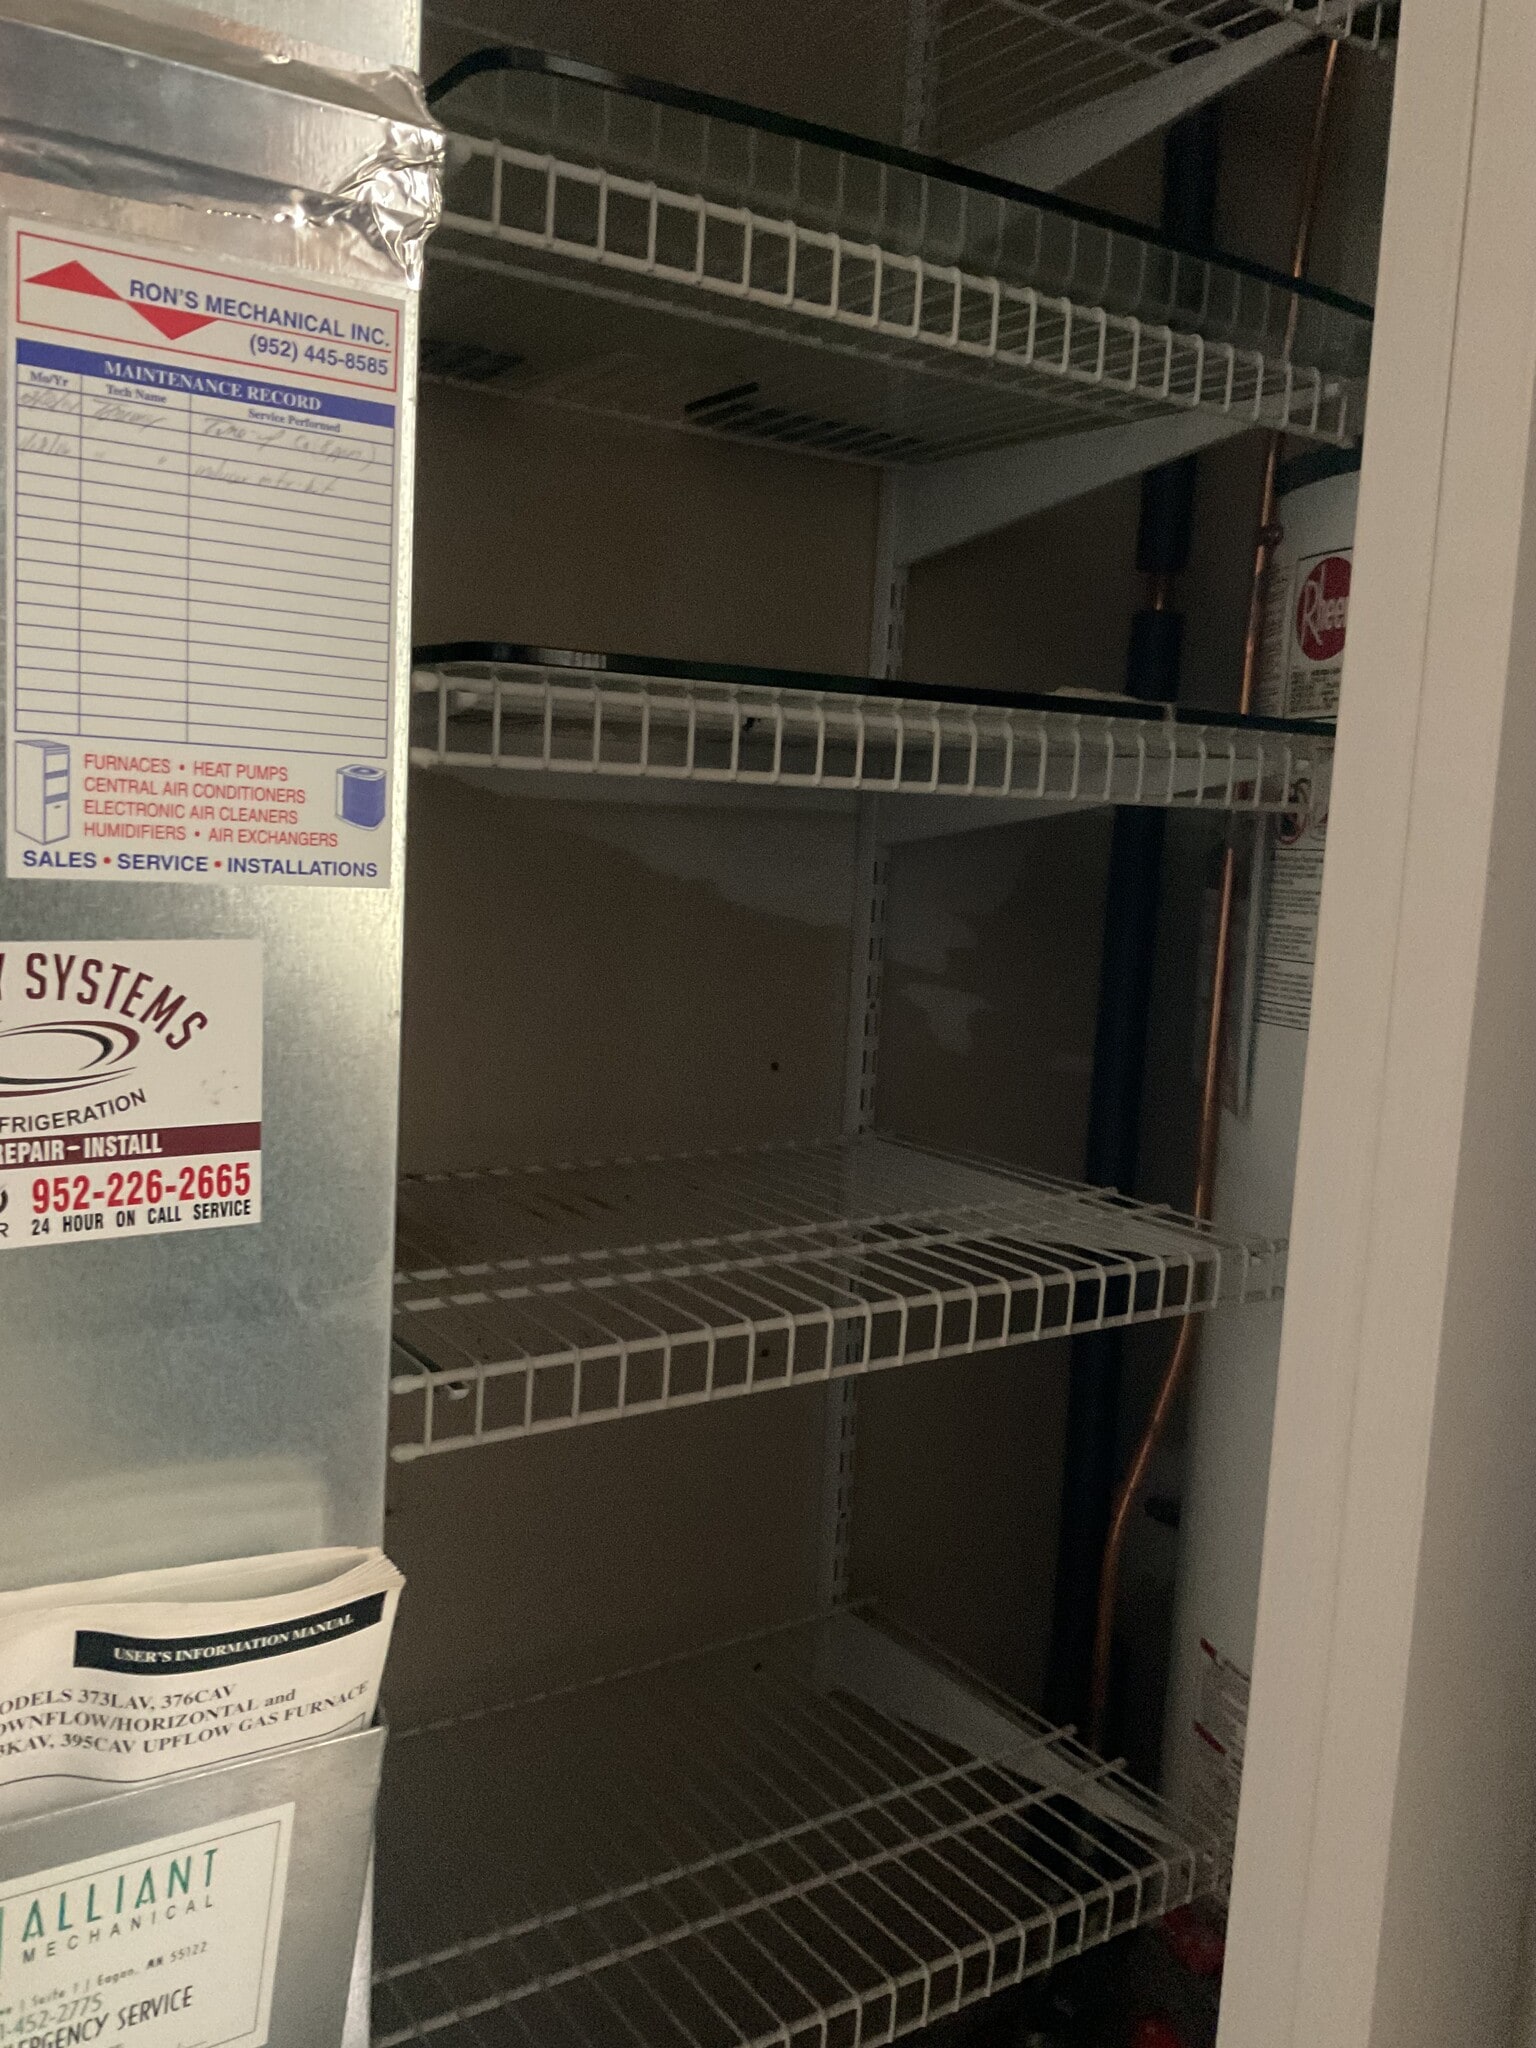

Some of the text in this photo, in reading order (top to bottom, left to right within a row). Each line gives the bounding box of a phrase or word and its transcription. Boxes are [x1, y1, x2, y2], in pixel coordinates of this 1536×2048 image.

[130, 279, 390, 347] RON'S MECHANICAL INC.
[249, 333, 388, 376] (952) 445-8585
[30, 371, 69, 387] Mo/Yr
[104, 360, 321, 411] MAINTENANCE RECORD
[106, 384, 167, 404] Tech Name
[248, 409, 341, 433] Service Performed
[1301, 562, 1350, 650] Rhee
[83, 753, 288, 782] FURNACES HEAT PUMPS
[84, 776, 306, 804] CENTRAL AIR CONDITIONERS
[84, 800, 298, 825] ELECTRONIC AIR CLEANERS
[84, 822, 338, 848] HUMIDIFIERS AIR EXCHANGERS
[23, 850, 378, 878] SALES SERVICE INSTALLATIONS
[26, 952, 208, 1050] SYSTEMS
[32, 1162, 251, 1214] 952-226-2665
[31, 1199, 252, 1236] 24 HOUR ON CALL SERVICE
[113, 1613, 354, 1663] USER'S INFORMATION MANUAL
[160, 1683, 238, 1709] 376CAV
[264, 1688, 297, 1707] and
[60, 1732, 137, 1754] 395CAV
[142, 1723, 235, 1754] UPFLOW
[238, 1711, 279, 1732] GAS
[283, 1680, 369, 1722] FURNACE
[21, 1848, 218, 1943] ALLIANT
[22, 1894, 214, 1964] MECHANICAL
[170, 1941, 208, 1963] 55122
[117, 1985, 194, 2031] SERVICE
